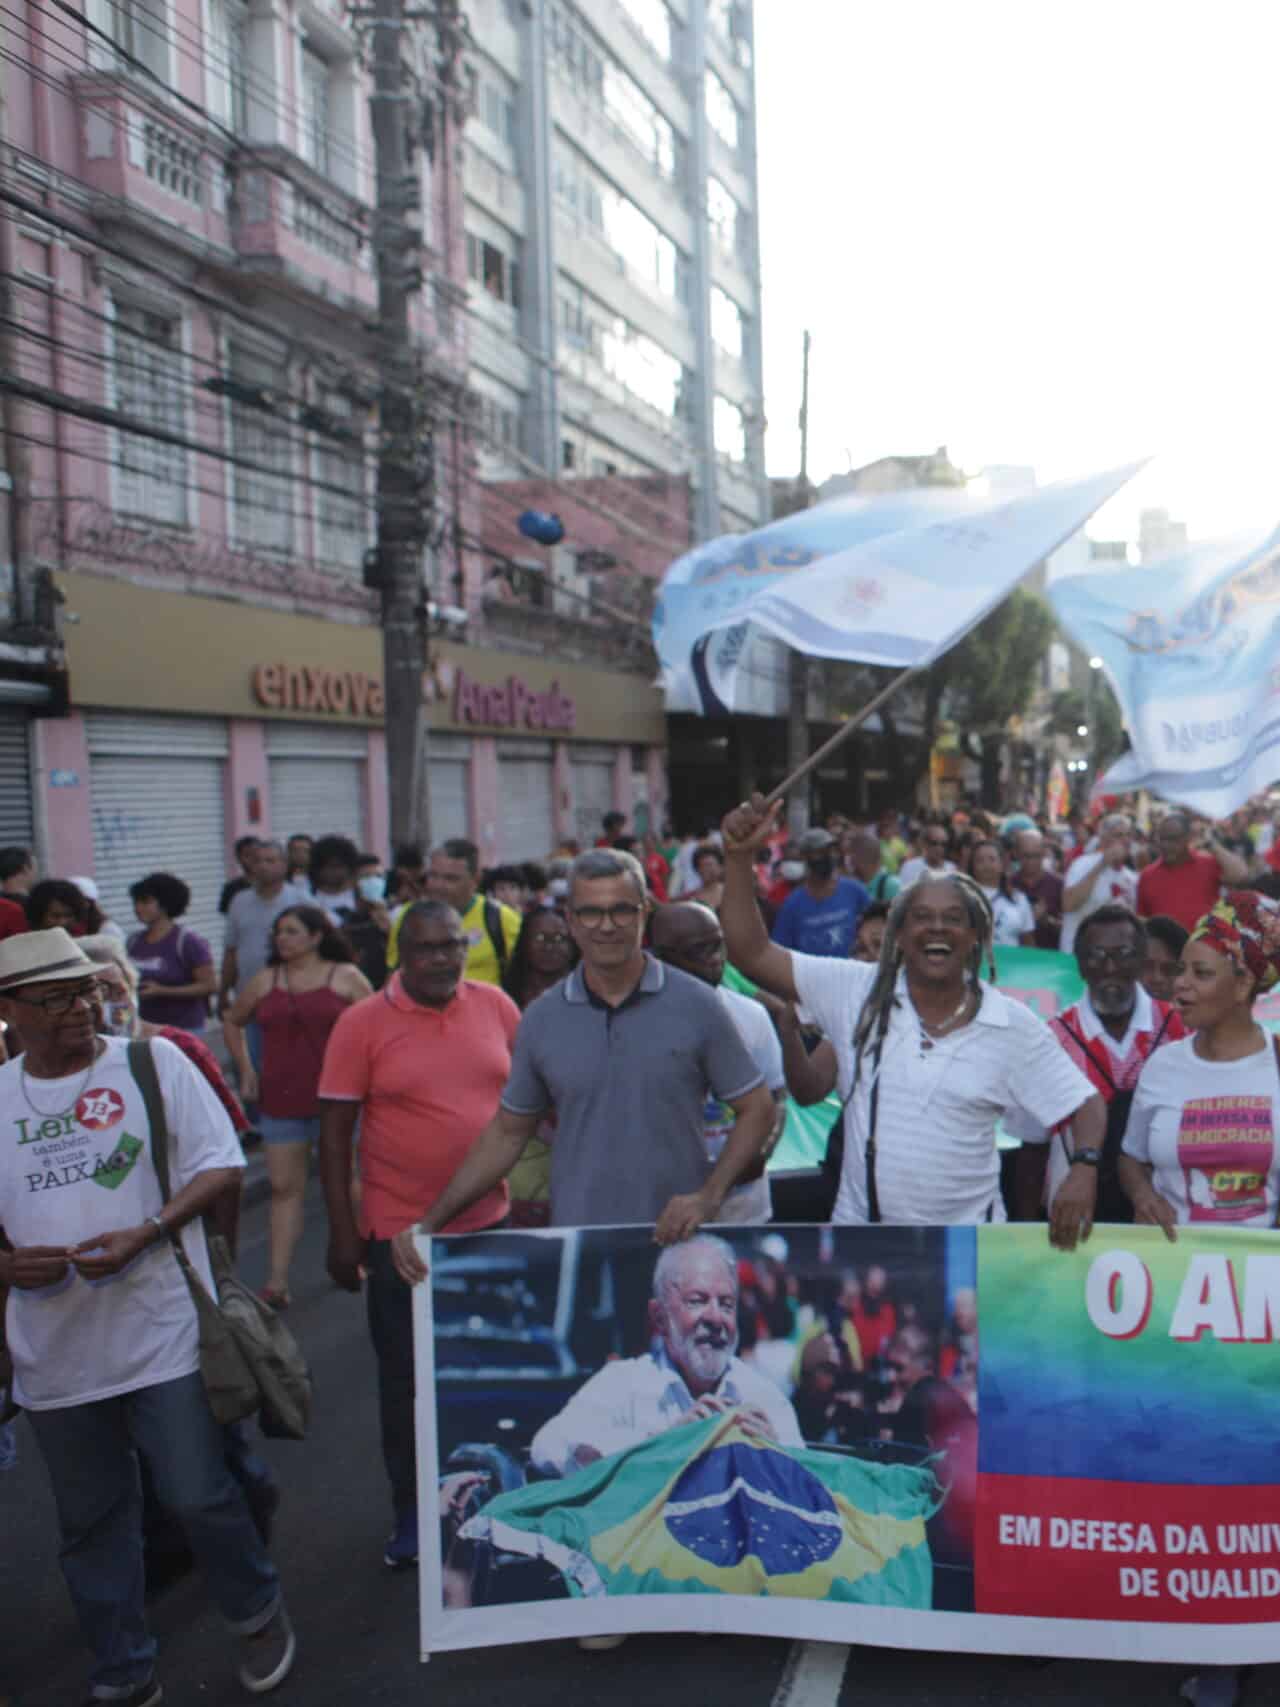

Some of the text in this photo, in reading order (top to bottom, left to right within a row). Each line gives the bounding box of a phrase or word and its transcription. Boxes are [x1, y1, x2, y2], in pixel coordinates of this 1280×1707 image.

[254, 664, 386, 717] enxova
[91, 1101, 108, 1115] 13
[14, 1114, 77, 1145] Ler
[1085, 1250, 1153, 1341] O
[999, 1514, 1041, 1548] EM
[1050, 1517, 1157, 1554] DEFESA
[1165, 1525, 1210, 1555] DA
[1119, 1567, 1160, 1597] DE
